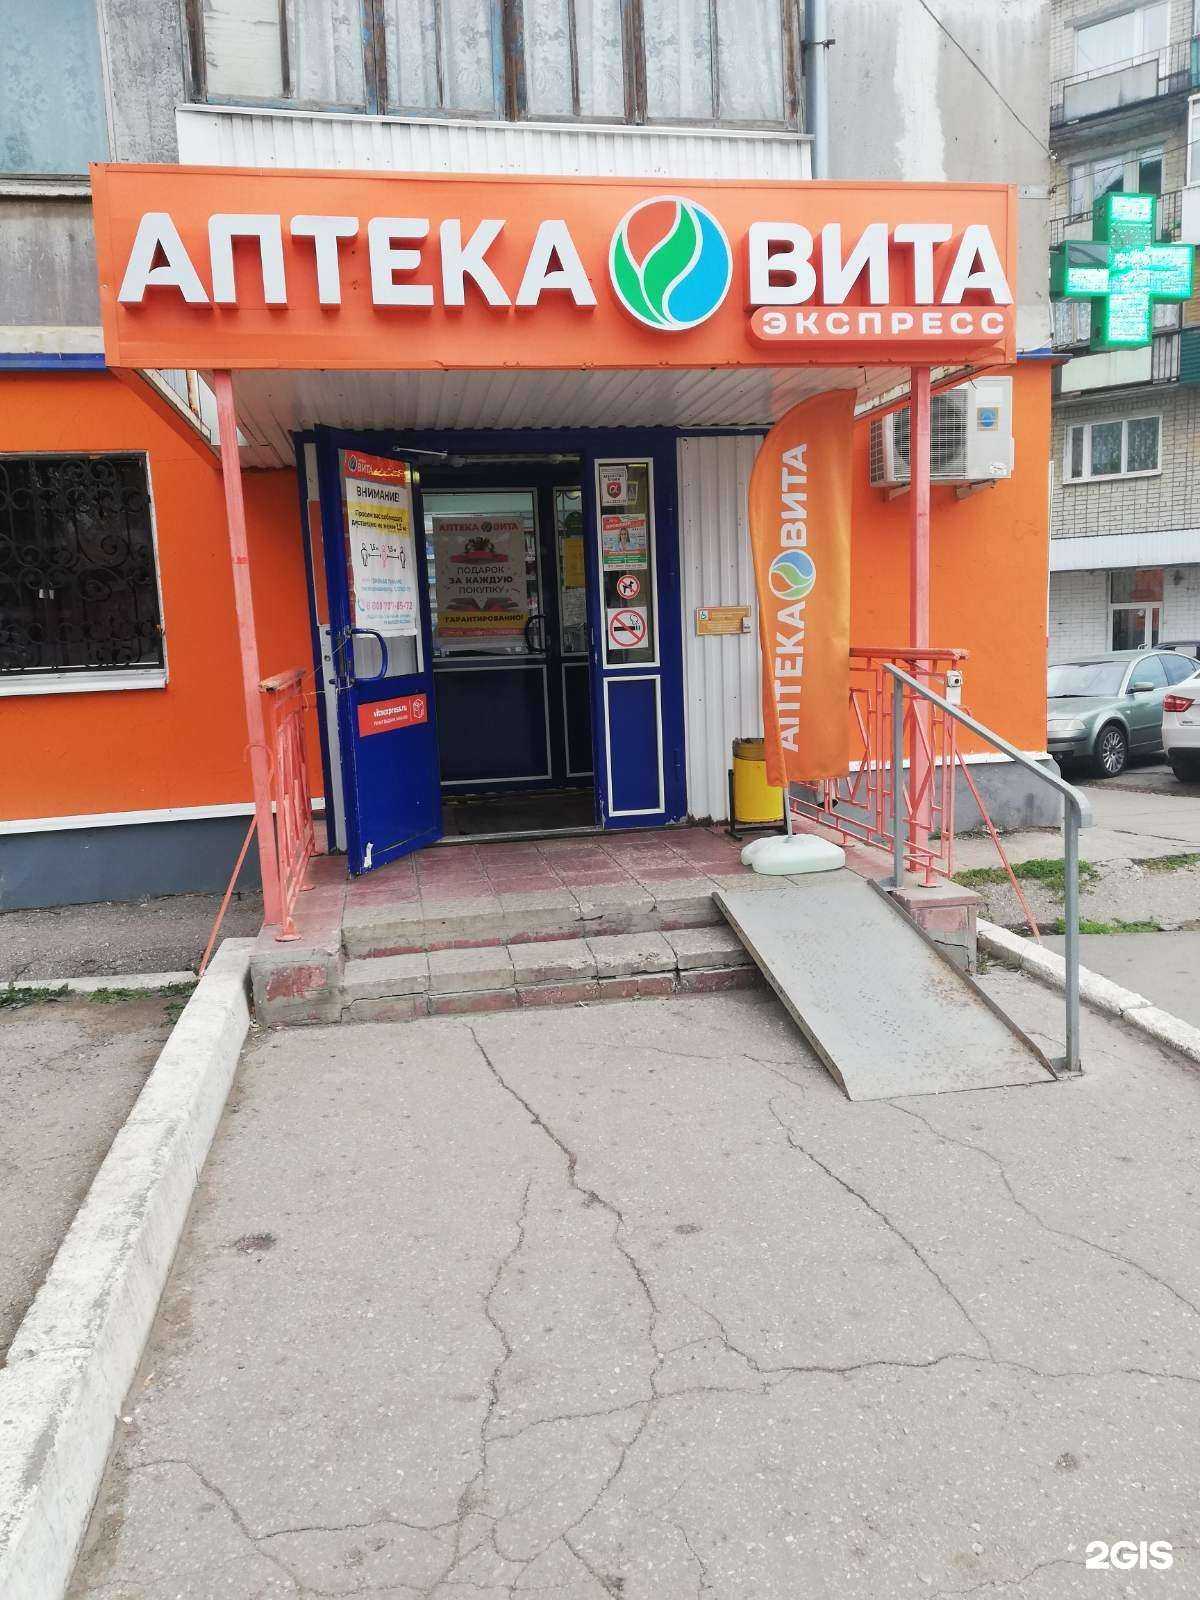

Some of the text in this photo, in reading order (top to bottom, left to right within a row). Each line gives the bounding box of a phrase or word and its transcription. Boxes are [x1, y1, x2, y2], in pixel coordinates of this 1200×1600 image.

[117, 212, 1013, 306] АПТЕКА ВИТА
[762, 312, 1005, 335] ЭКСПРЕСС
[439, 523, 479, 532] АПТЕКА
[457, 566, 505, 575] ПОДАРОК
[465, 576, 513, 584] КАЖДУЮ
[459, 586, 505, 594] ПОКУПКУ
[774, 444, 807, 752] АПТЕКА ВИТА
[445, 614, 524, 623] ГАРАНТИРОВАННО!
